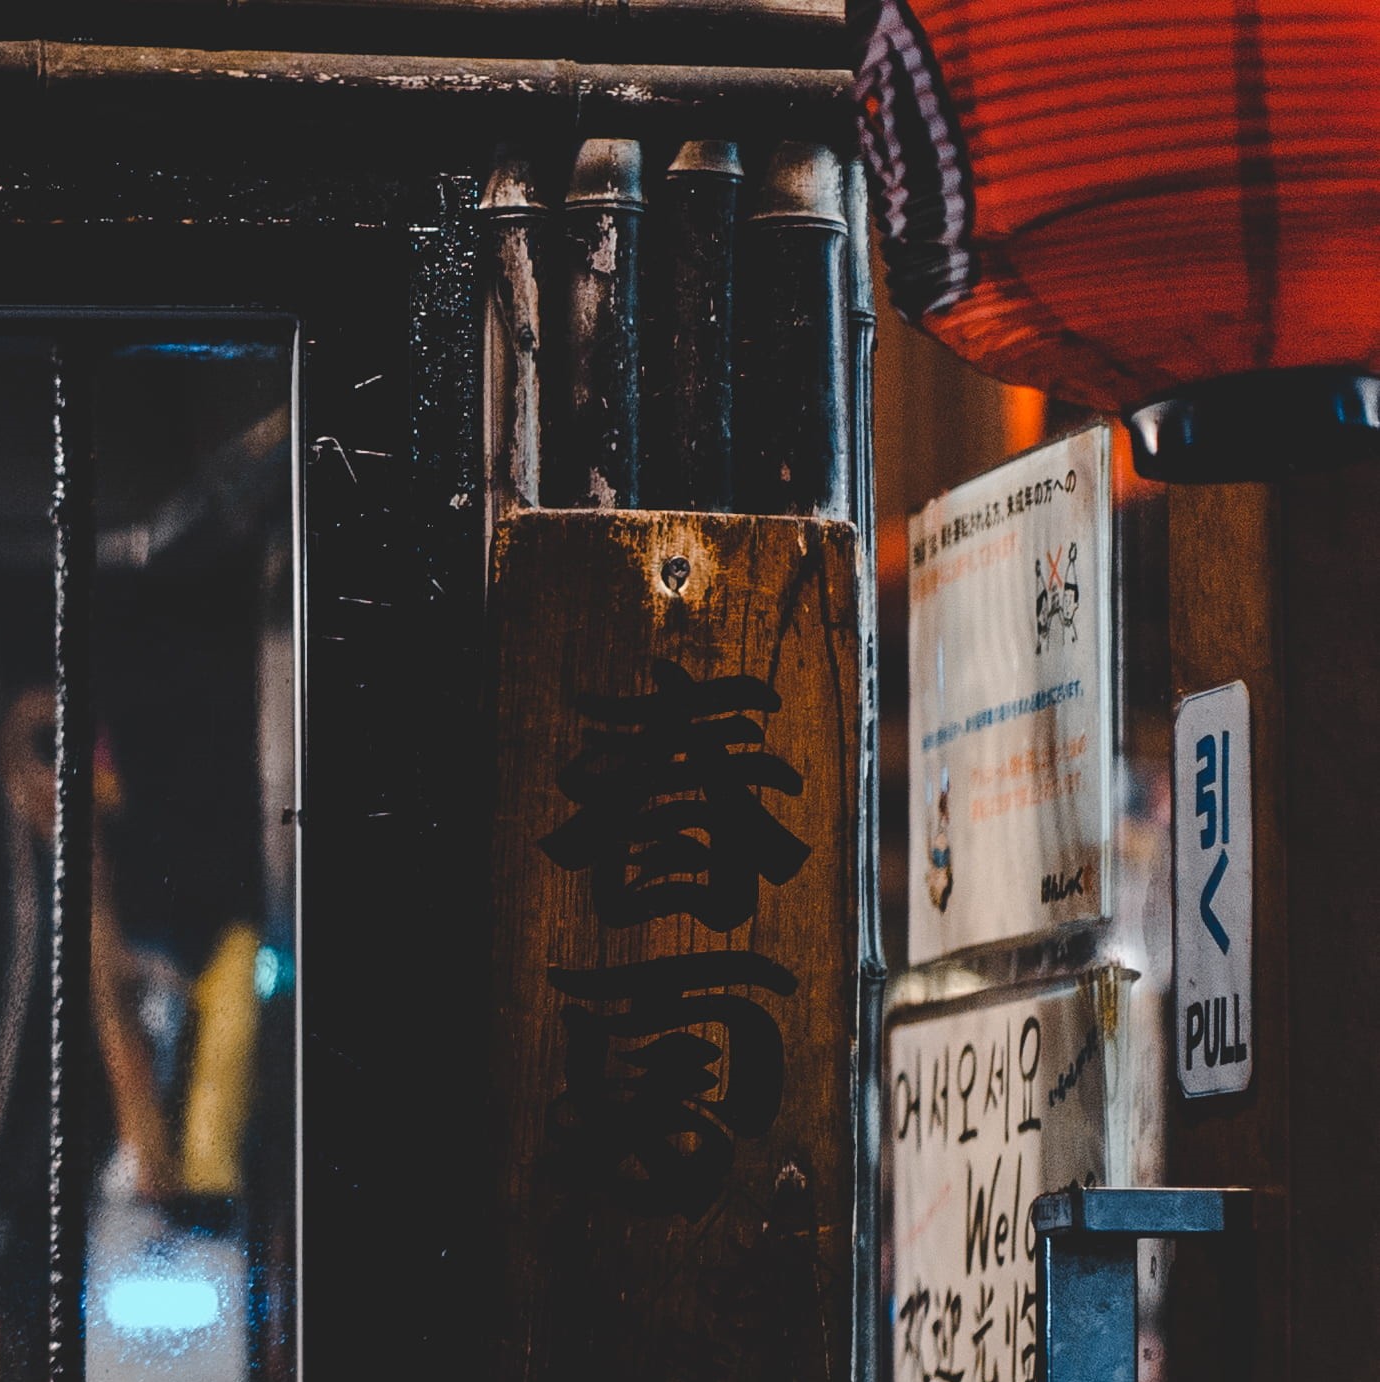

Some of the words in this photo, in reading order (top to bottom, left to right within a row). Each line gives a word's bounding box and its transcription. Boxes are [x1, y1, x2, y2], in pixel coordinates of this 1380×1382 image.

[1195, 730, 1230, 956] 引く
[896, 1015, 1042, 1152] 어서오세요
[1186, 993, 1247, 1070] PULL
